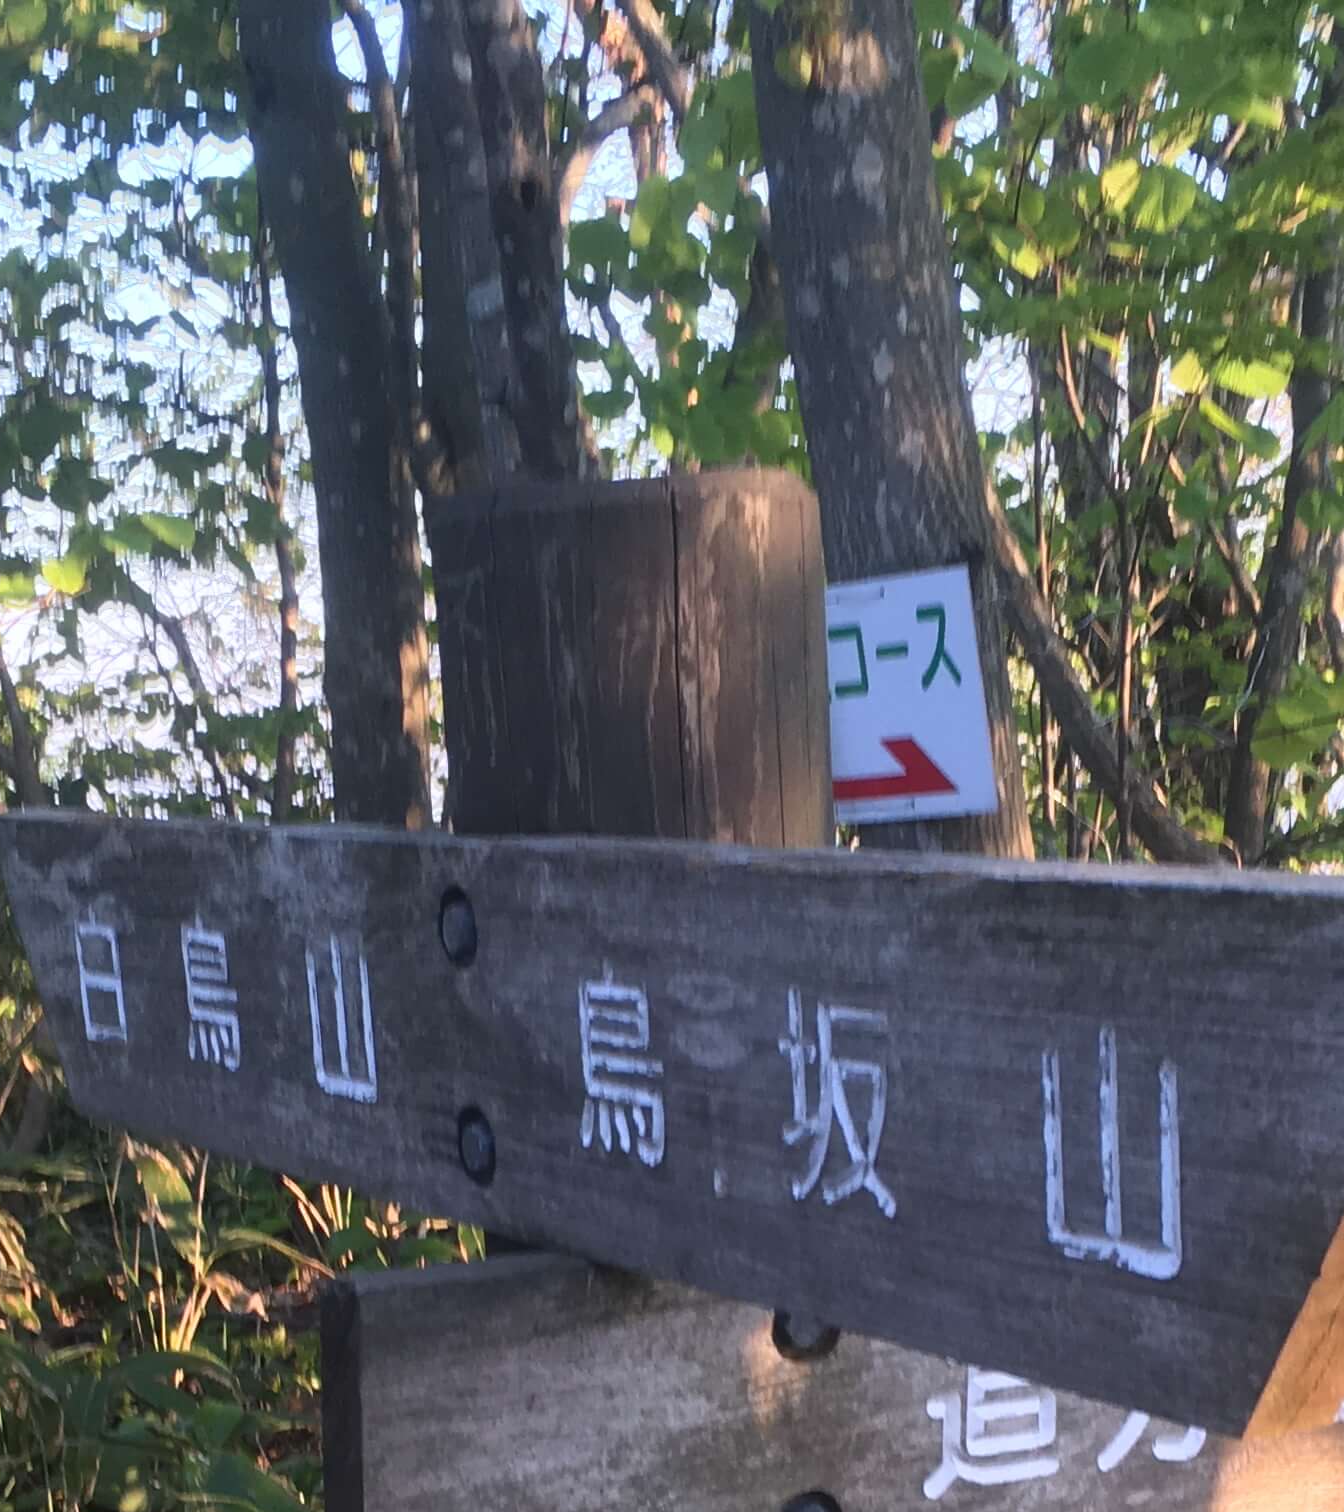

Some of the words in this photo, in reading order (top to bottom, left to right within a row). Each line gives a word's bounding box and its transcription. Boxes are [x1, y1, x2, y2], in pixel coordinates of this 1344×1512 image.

[74, 904, 378, 1104] 白鳥山
[579, 964, 1182, 1281] 鳥坂山
